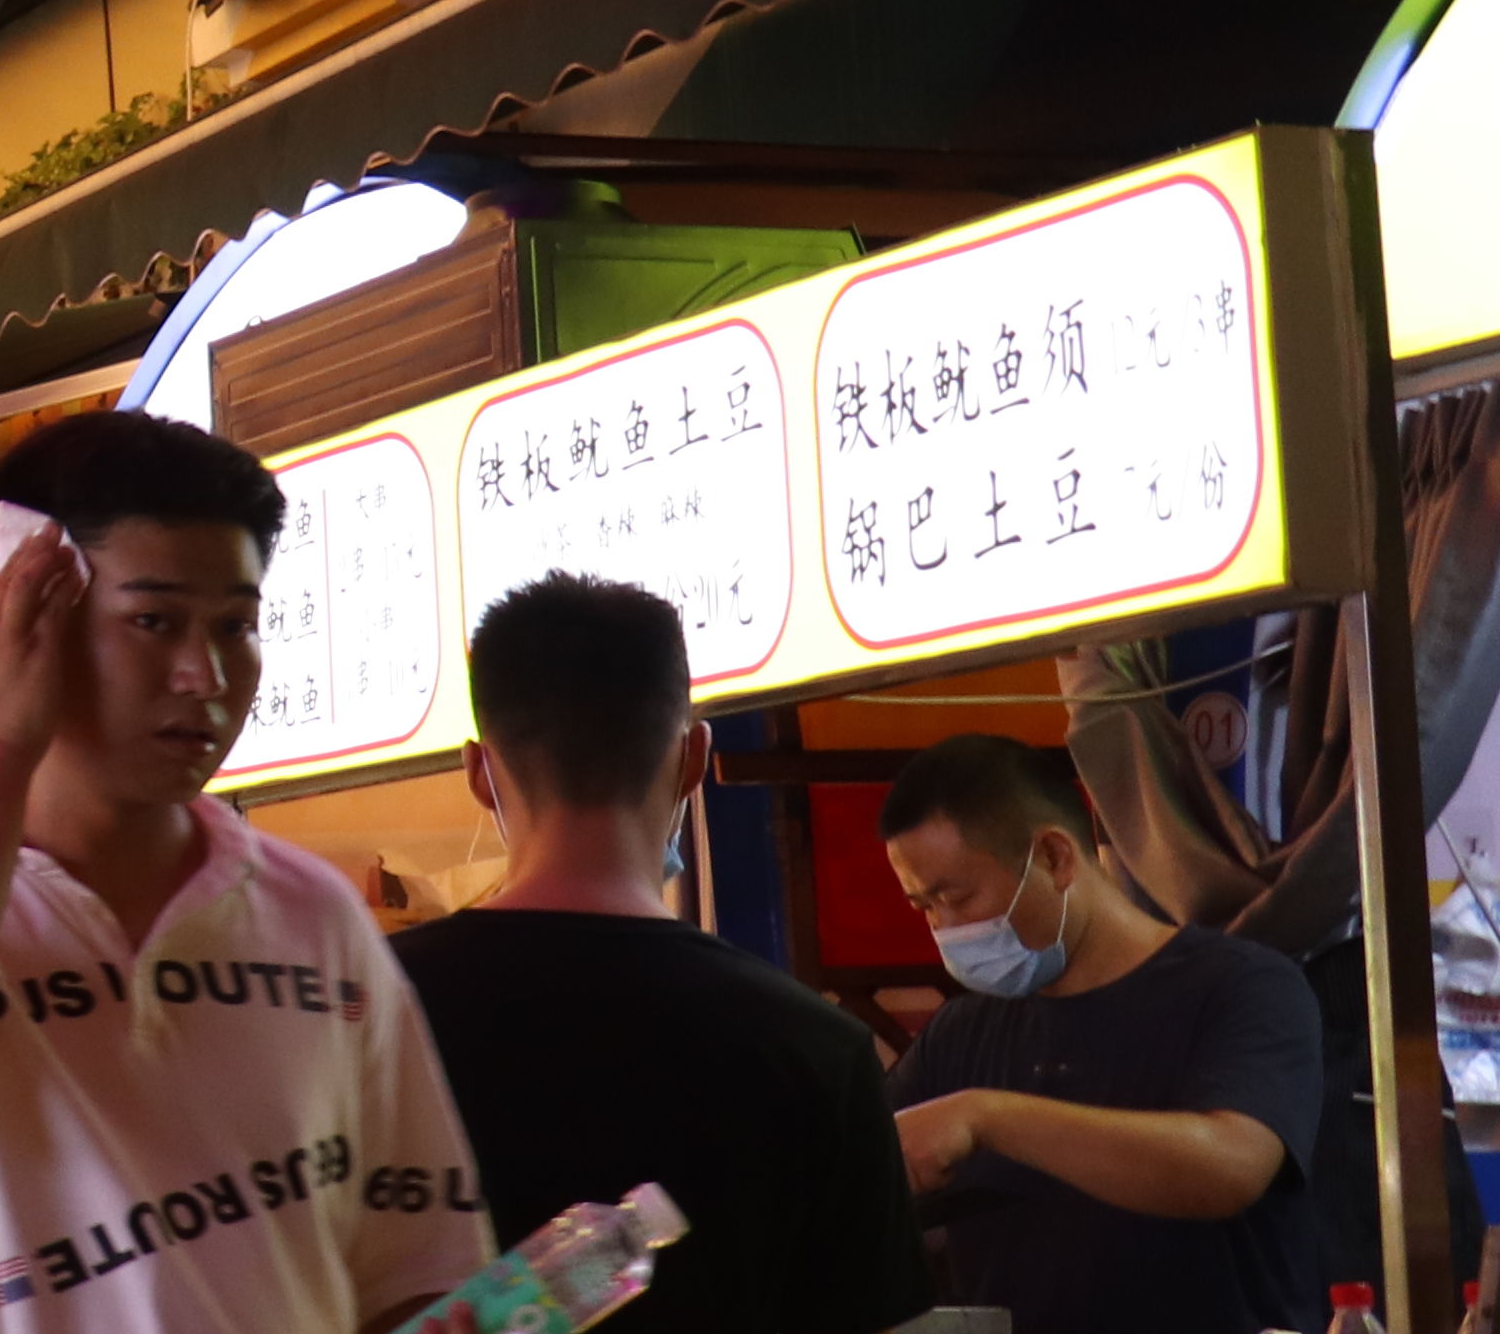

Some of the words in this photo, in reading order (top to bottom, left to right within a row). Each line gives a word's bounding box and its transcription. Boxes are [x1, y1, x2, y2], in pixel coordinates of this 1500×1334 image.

[473, 362, 766, 513] 铁板鱿鱼土豆
[832, 297, 1090, 454] 铁板鱿鱼须
[841, 447, 1097, 587] 锅巴土豆
[1193, 713, 1238, 751] 01
[34, 1171, 254, 1295] ROUTE
